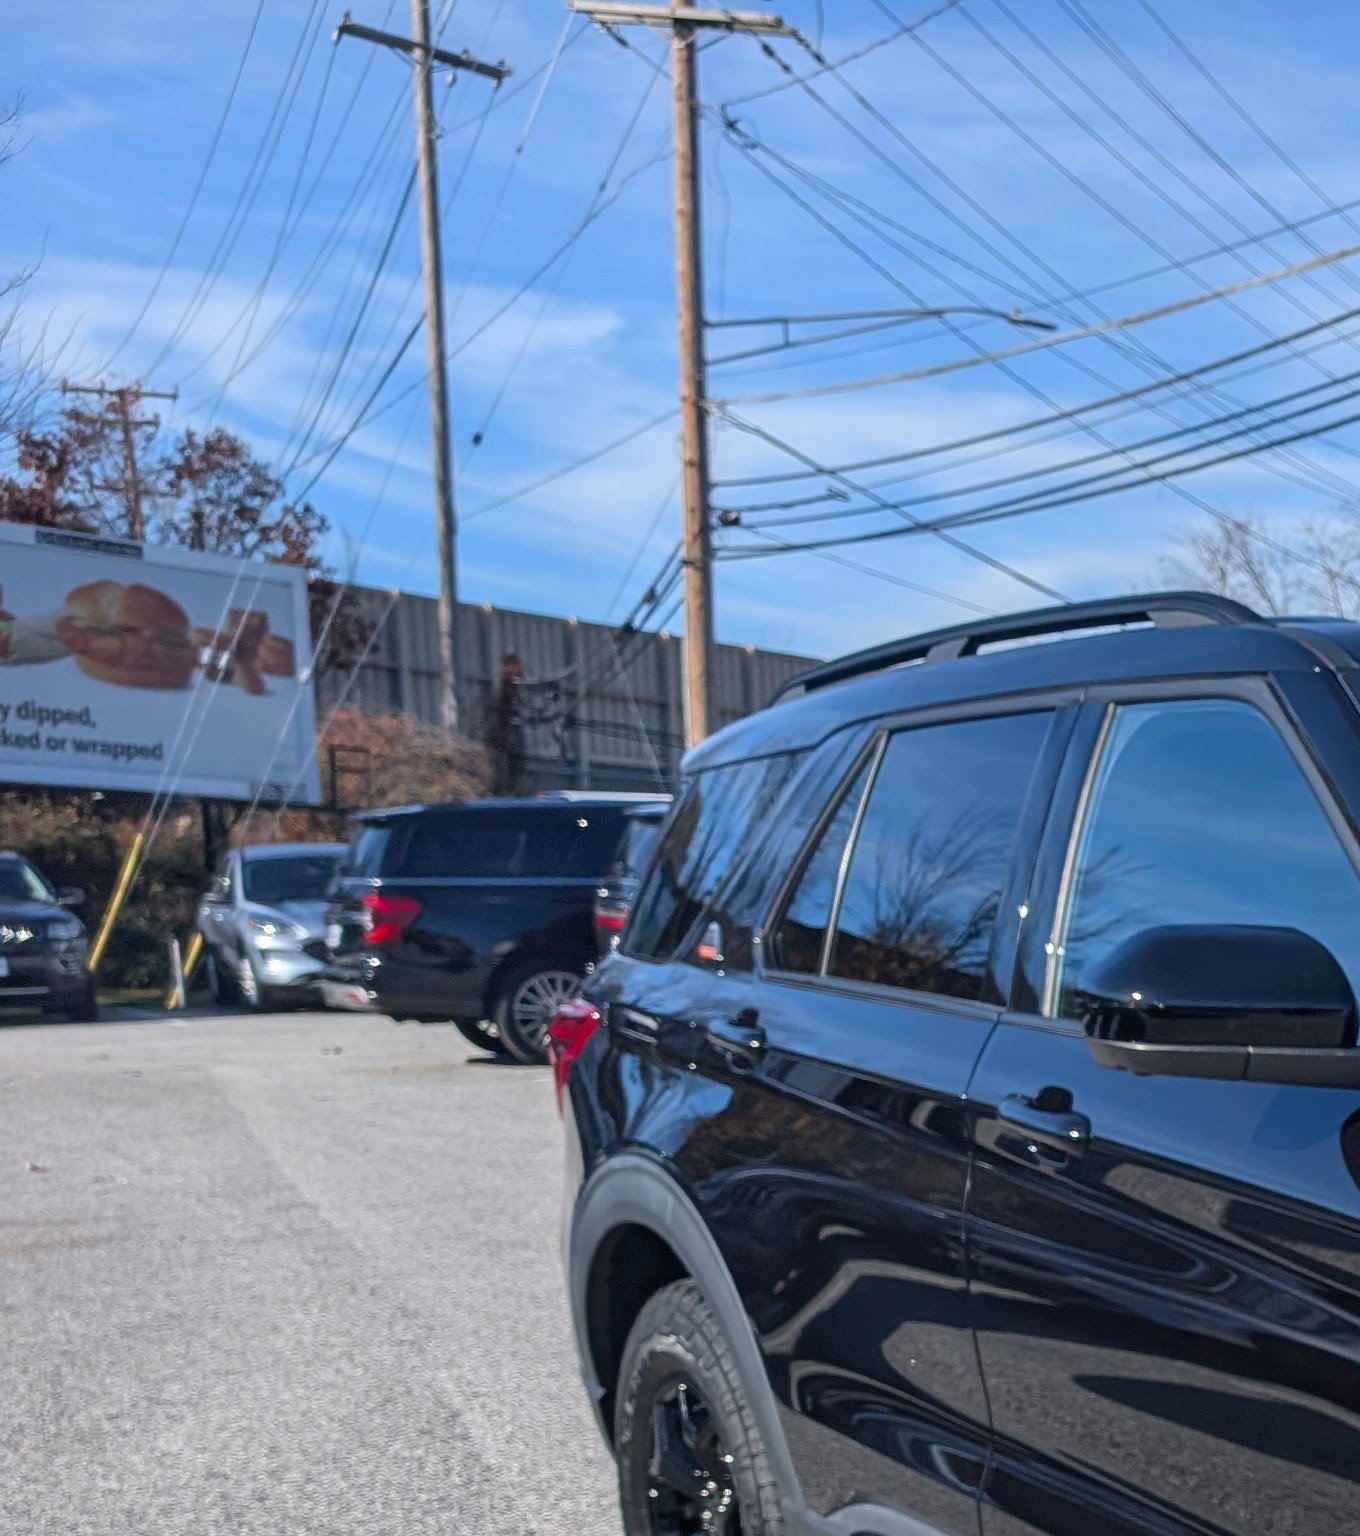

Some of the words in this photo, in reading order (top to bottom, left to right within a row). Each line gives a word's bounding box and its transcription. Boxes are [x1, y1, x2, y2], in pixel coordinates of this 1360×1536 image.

[16, 699, 97, 728] dipped,
[45, 735, 67, 752] or
[72, 738, 164, 764] wrapped
